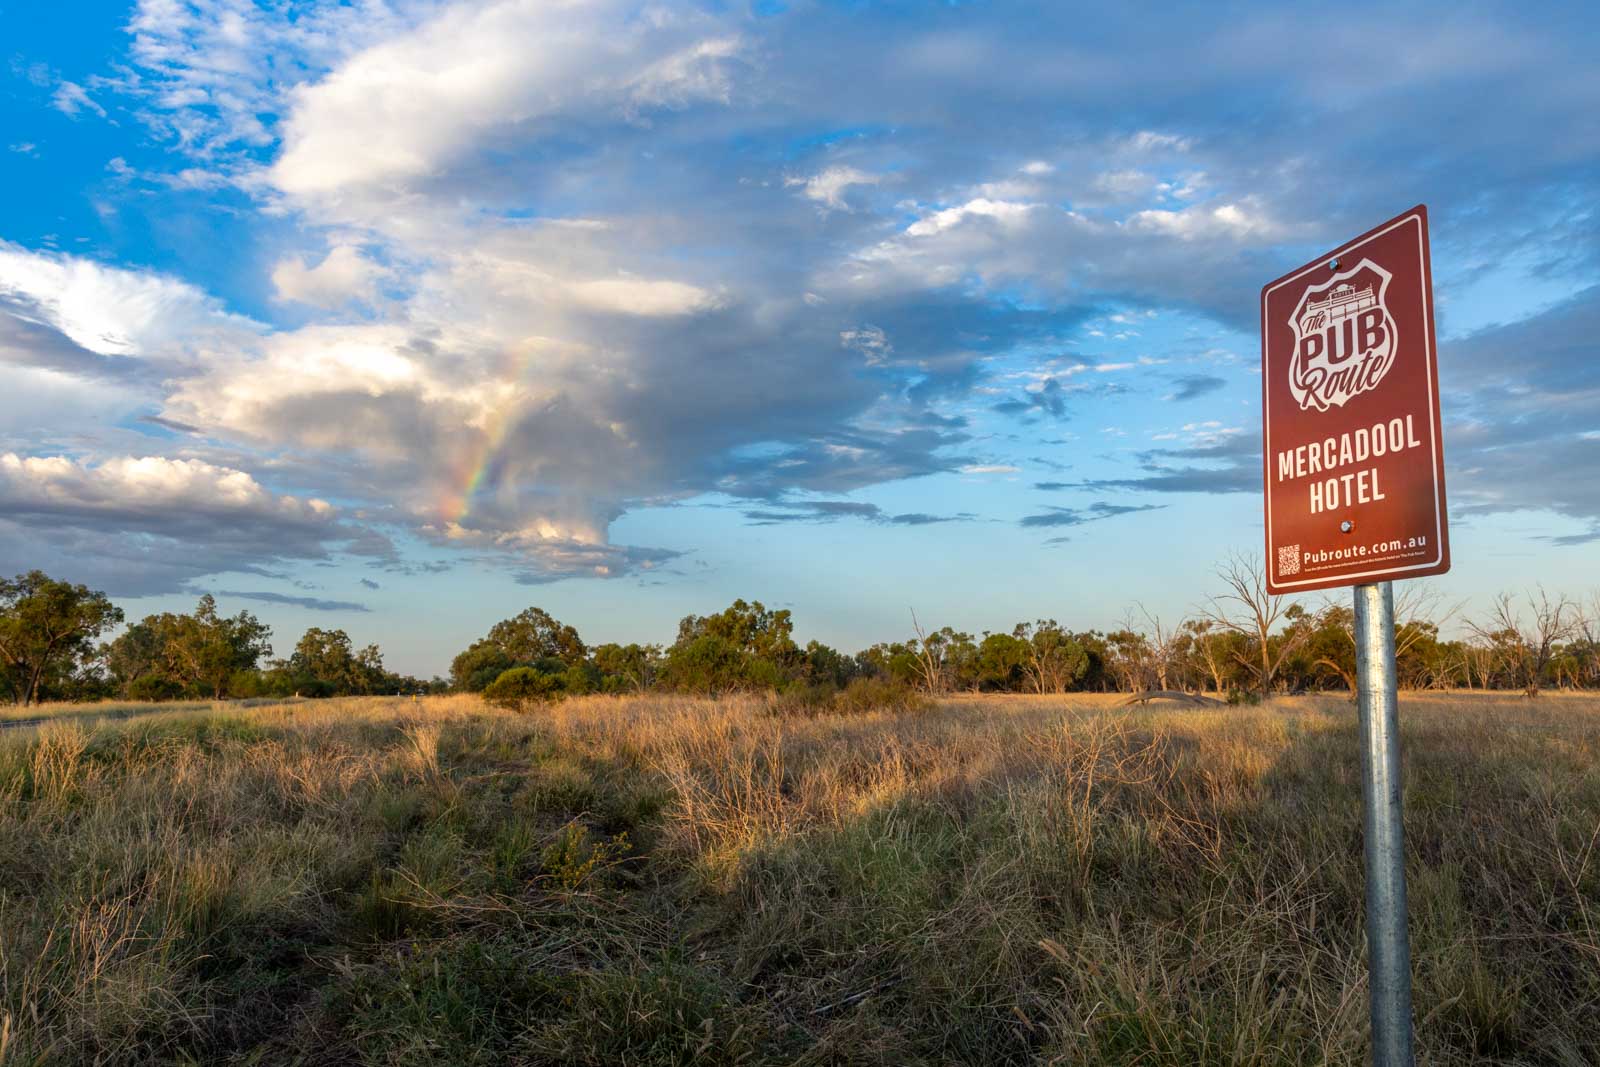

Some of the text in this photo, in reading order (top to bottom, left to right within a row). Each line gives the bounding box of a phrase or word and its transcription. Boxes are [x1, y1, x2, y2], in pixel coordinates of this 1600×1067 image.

[1300, 307, 1386, 376] PUB
[1302, 310, 1327, 334] The
[1301, 350, 1384, 409] Route
[1278, 414, 1421, 482] MERCADOOL
[1310, 467, 1386, 514] HOTEL
[1304, 535, 1426, 565] Pubroute.com.au
